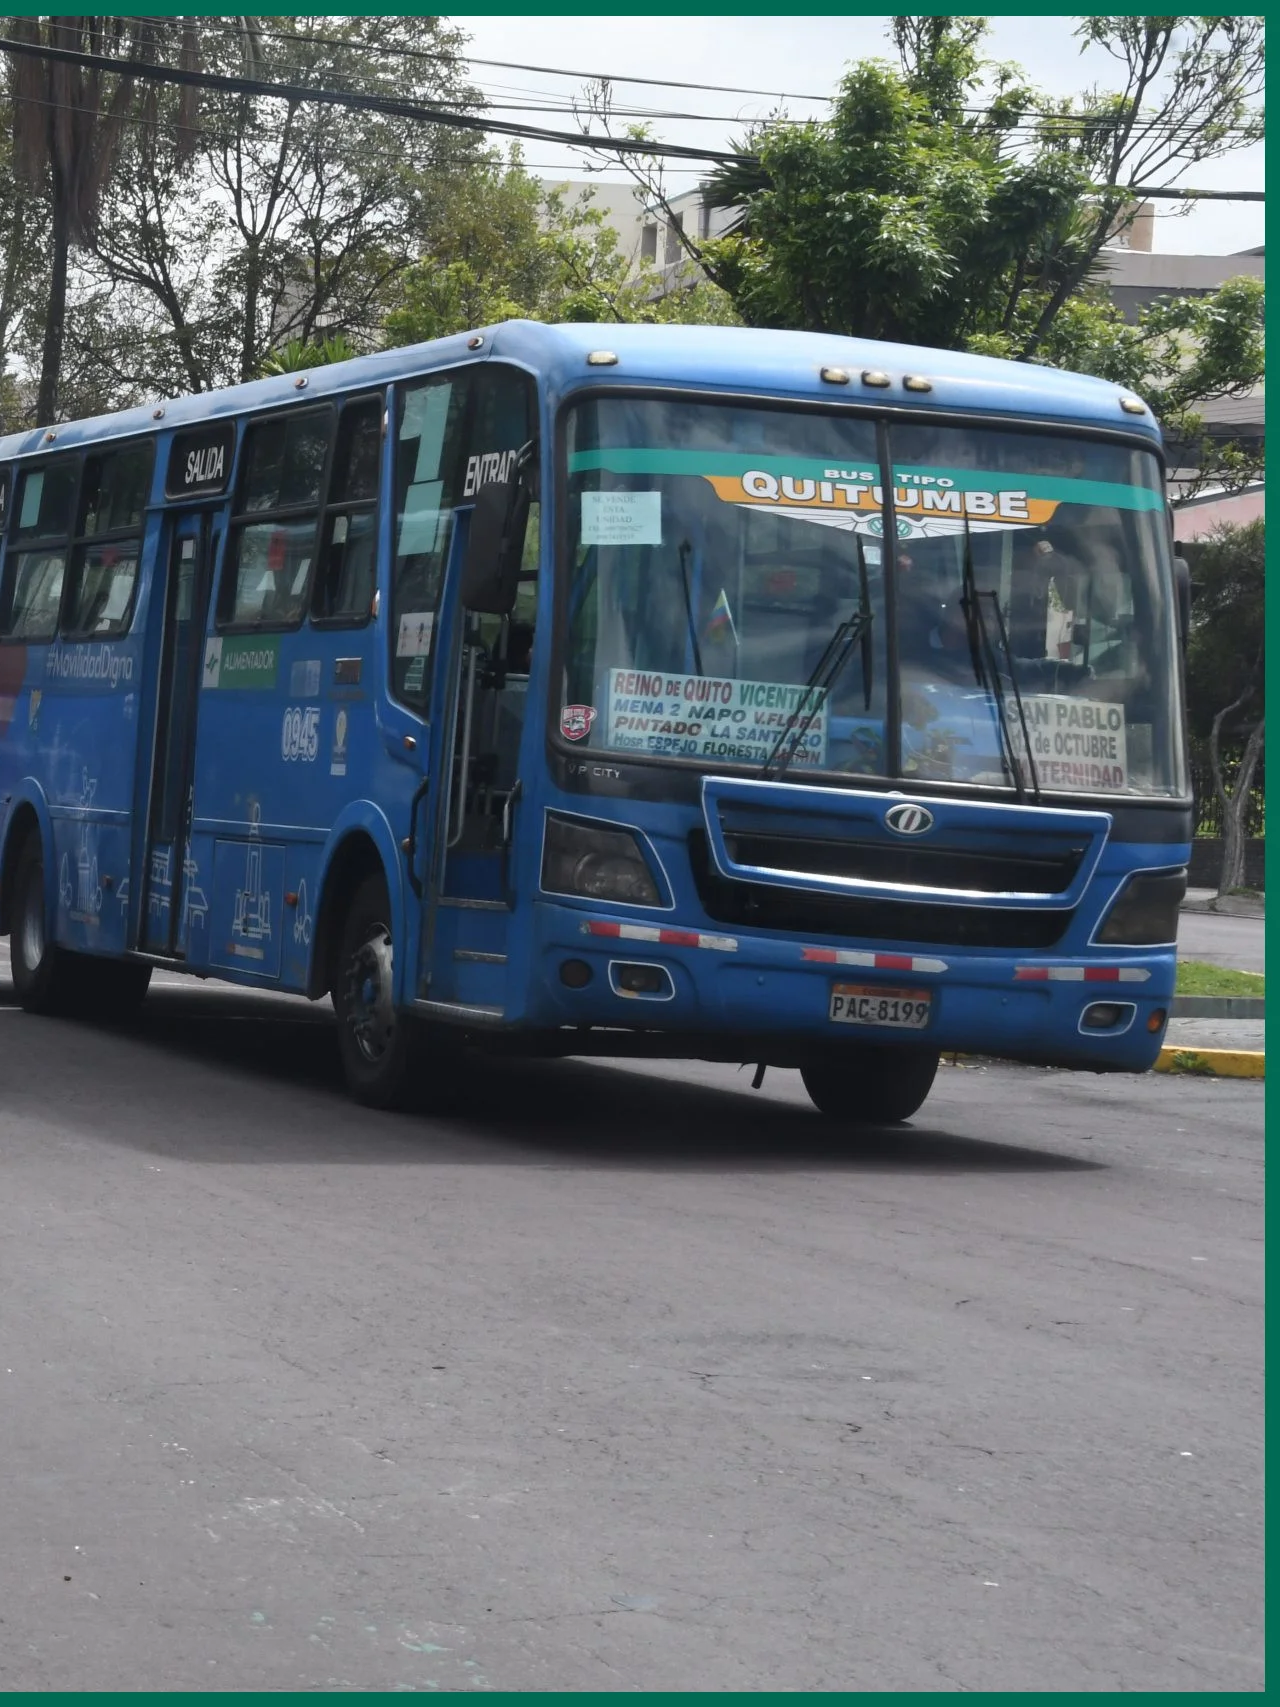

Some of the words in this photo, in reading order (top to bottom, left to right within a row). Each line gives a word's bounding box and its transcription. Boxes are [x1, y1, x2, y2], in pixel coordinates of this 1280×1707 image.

[185, 446, 224, 484] SALIDA
[823, 469, 875, 481] BUS
[896, 473, 954, 488] TIPO
[741, 470, 1029, 519] QUITUMBE
[46, 643, 133, 688] #MovilidadDigna
[223, 650, 275, 670] ALIMENTADOR
[614, 672, 663, 698] REINO
[683, 678, 732, 704] QUITO
[614, 698, 664, 717] MENA
[670, 703, 681, 717] 2
[688, 705, 746, 724] NAPO
[1007, 700, 1049, 725] SAN
[1056, 704, 1121, 731] PABLO
[282, 707, 320, 761] 0945
[615, 716, 702, 737] PINTADO
[710, 726, 731, 739] LA
[647, 736, 698, 754] ESPEJO
[703, 741, 768, 761] FLORESTA
[1035, 732, 1051, 754] de
[1054, 732, 1117, 759] OCTUBRE
[593, 767, 620, 778] CITY
[833, 996, 927, 1023] PAC-8199
